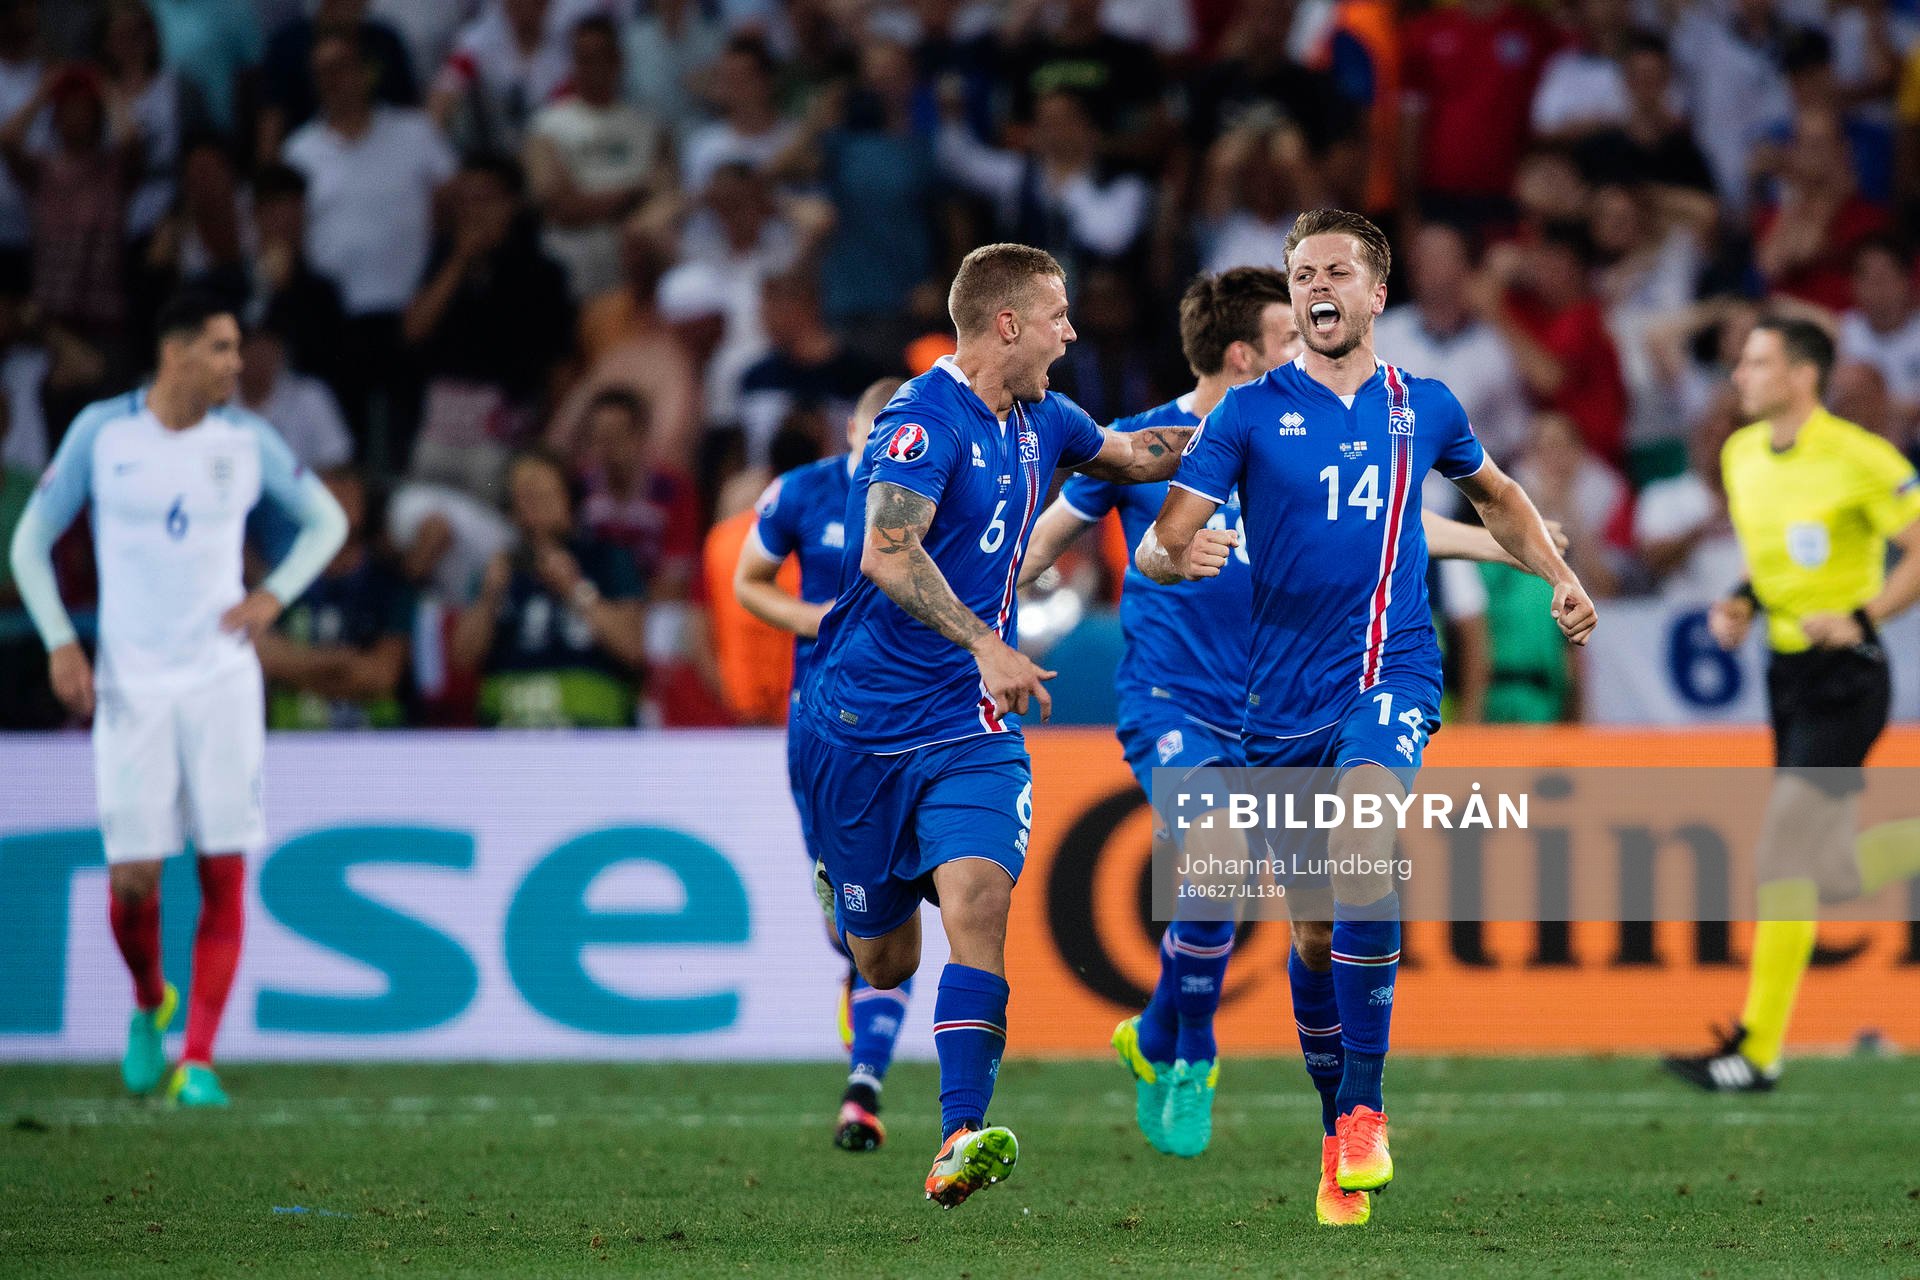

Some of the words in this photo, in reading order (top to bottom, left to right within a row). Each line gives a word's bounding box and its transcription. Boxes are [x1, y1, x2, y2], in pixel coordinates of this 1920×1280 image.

[1279, 427, 1307, 436] errea
[166, 493, 189, 540] 6
[1320, 465, 1384, 520] 14
[979, 500, 1006, 553] 6
[1668, 607, 1742, 707] 6
[1373, 692, 1424, 744] 14
[1016, 780, 1033, 830] 6
